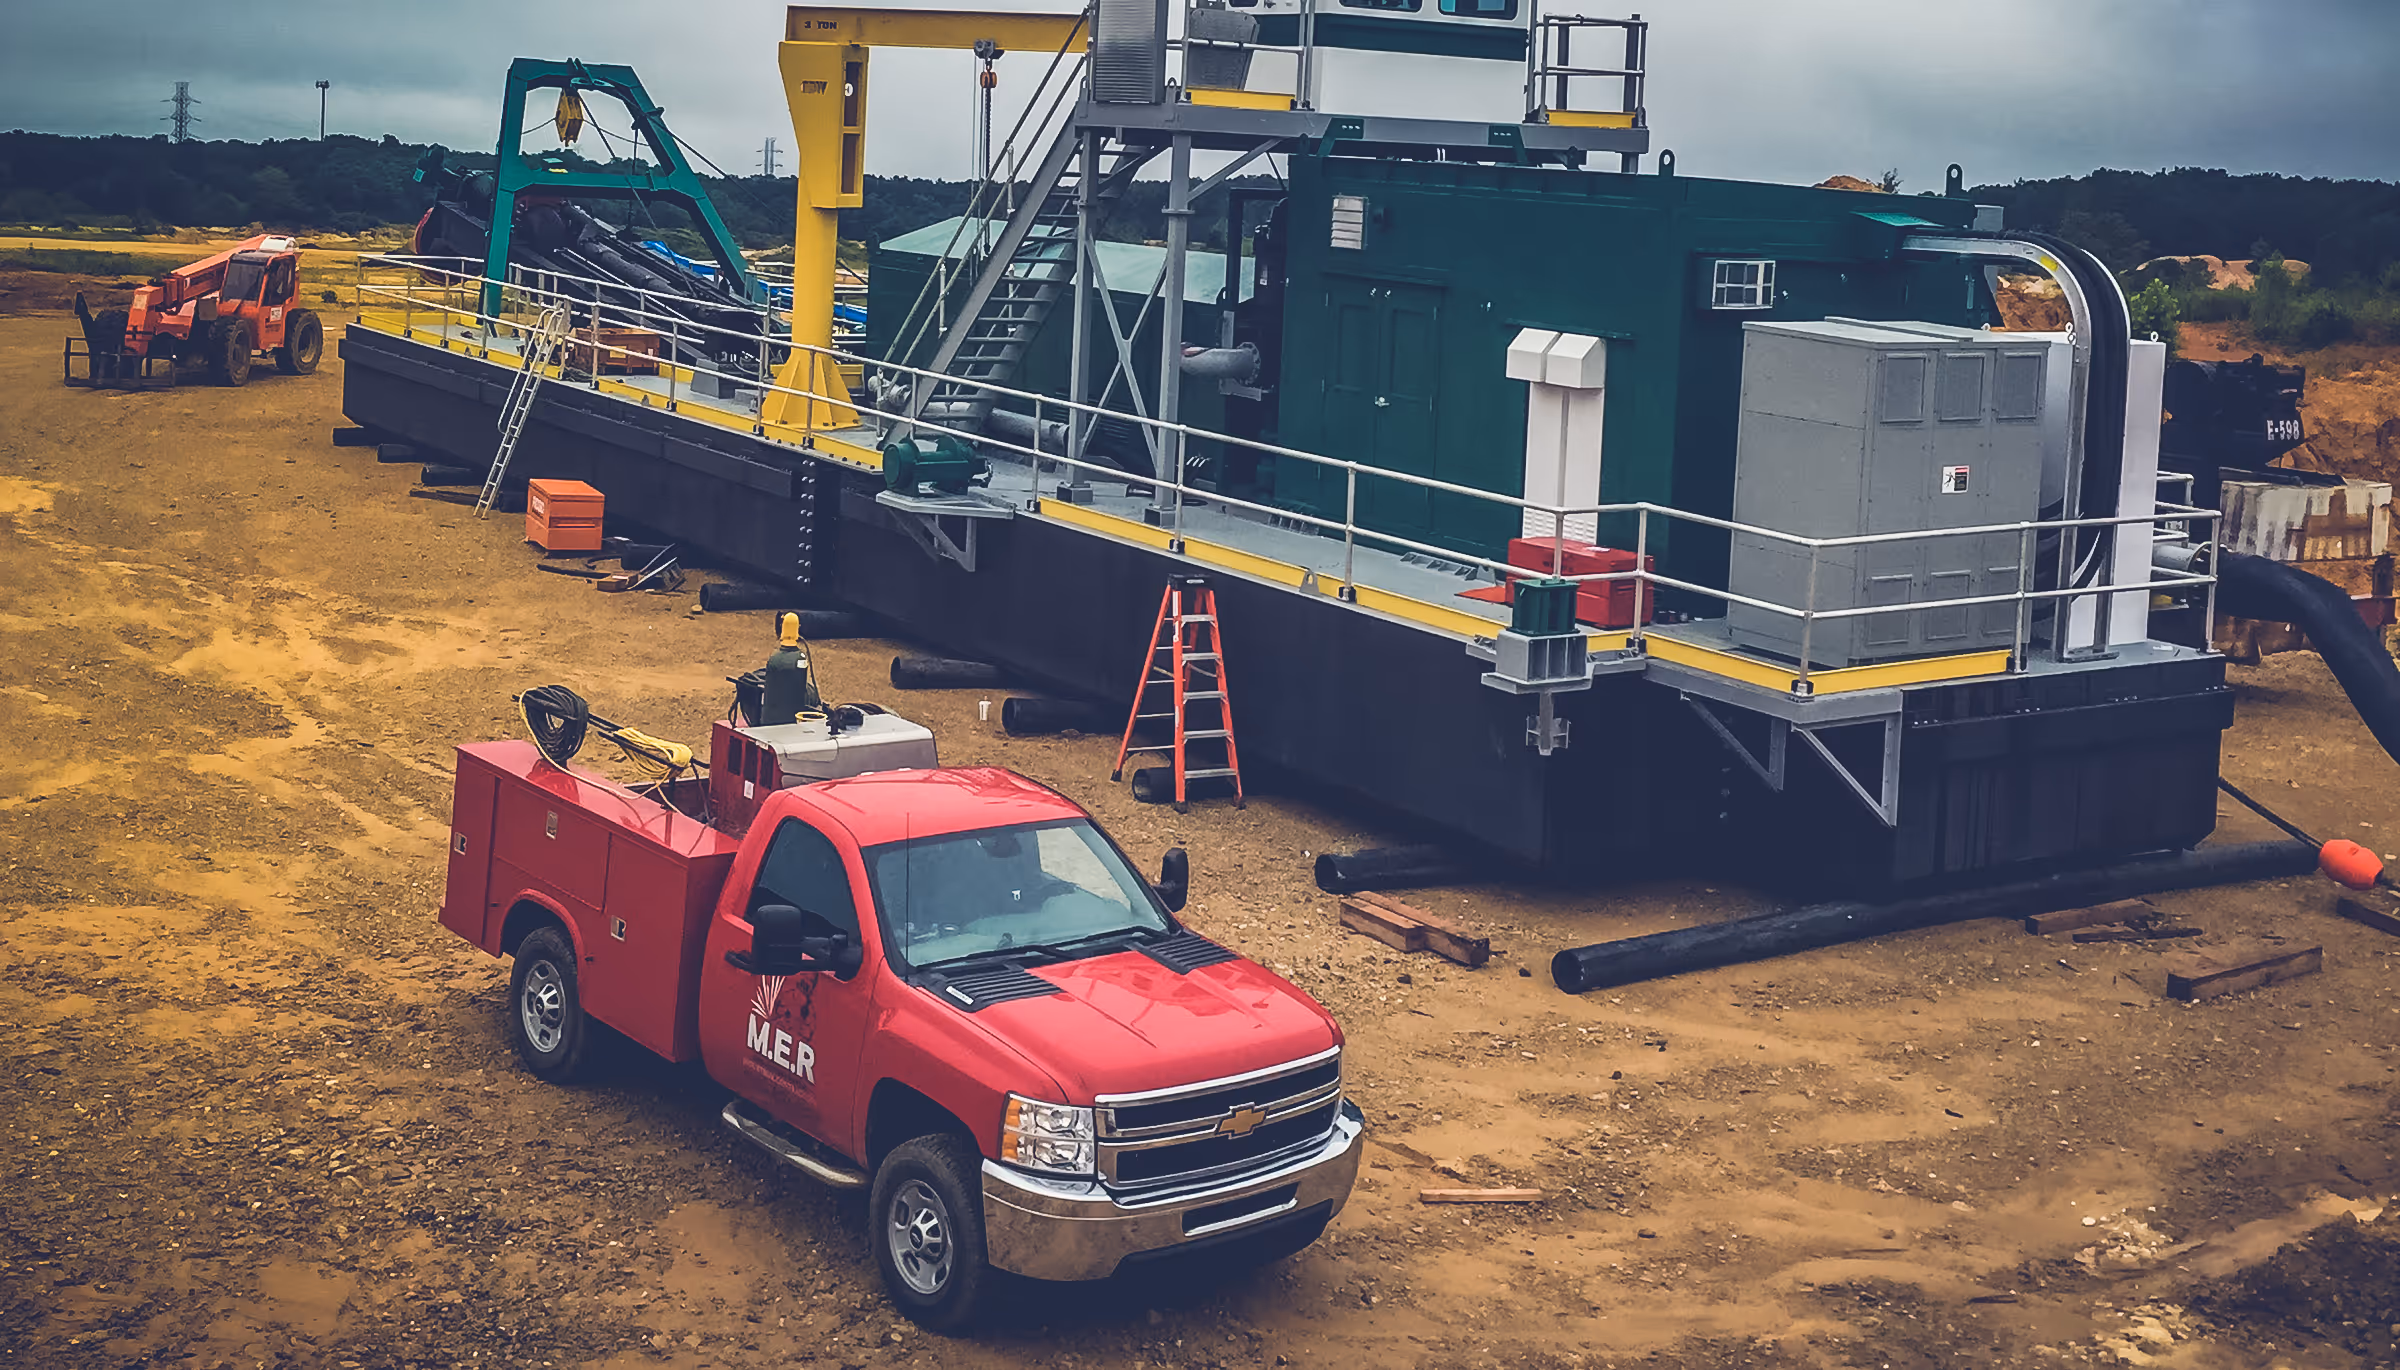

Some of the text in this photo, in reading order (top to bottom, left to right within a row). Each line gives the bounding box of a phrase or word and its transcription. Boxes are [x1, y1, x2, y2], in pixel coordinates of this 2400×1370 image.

[816, 20, 838, 30] TON
[2266, 419, 2300, 441] E-598
[747, 1012, 816, 1086] M.E.R
